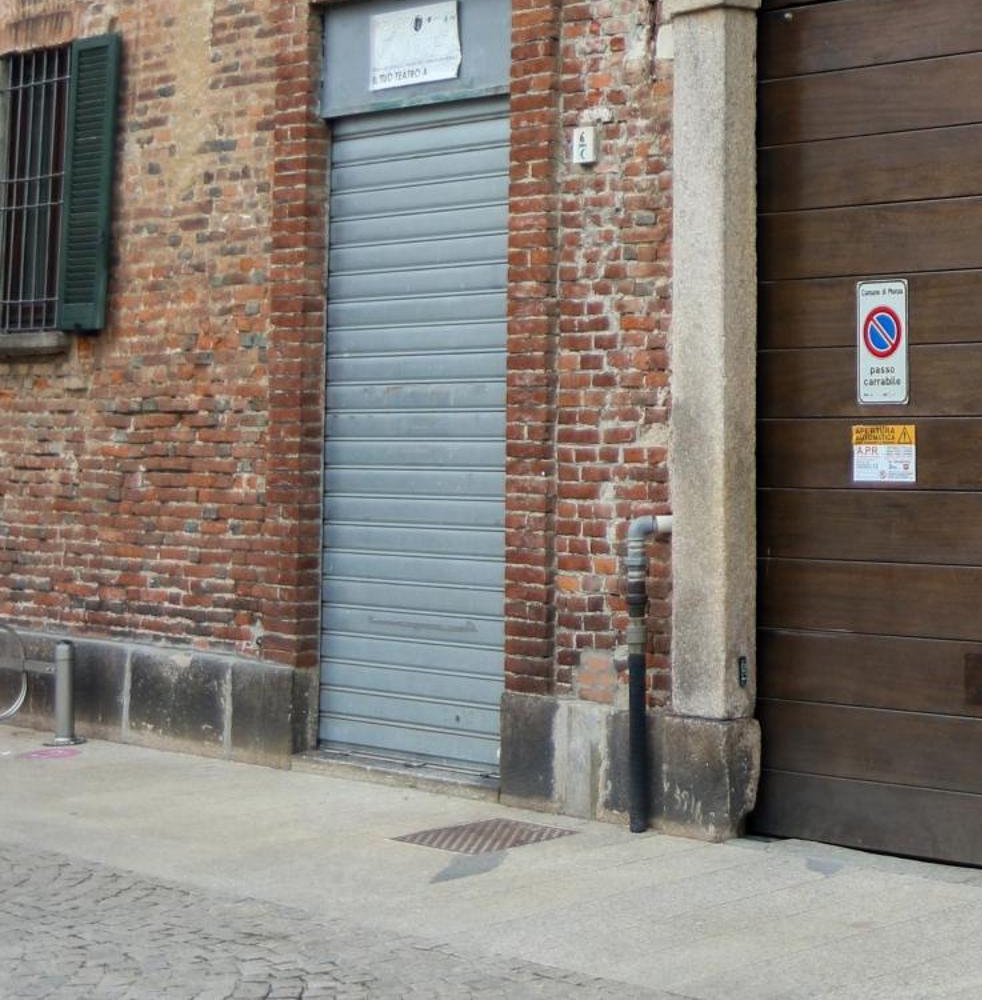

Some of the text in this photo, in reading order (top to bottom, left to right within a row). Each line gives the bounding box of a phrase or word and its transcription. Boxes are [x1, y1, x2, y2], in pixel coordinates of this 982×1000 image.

[395, 67, 421, 81] TEATRO
[870, 366, 896, 376] passo
[863, 377, 901, 387] carrabile
